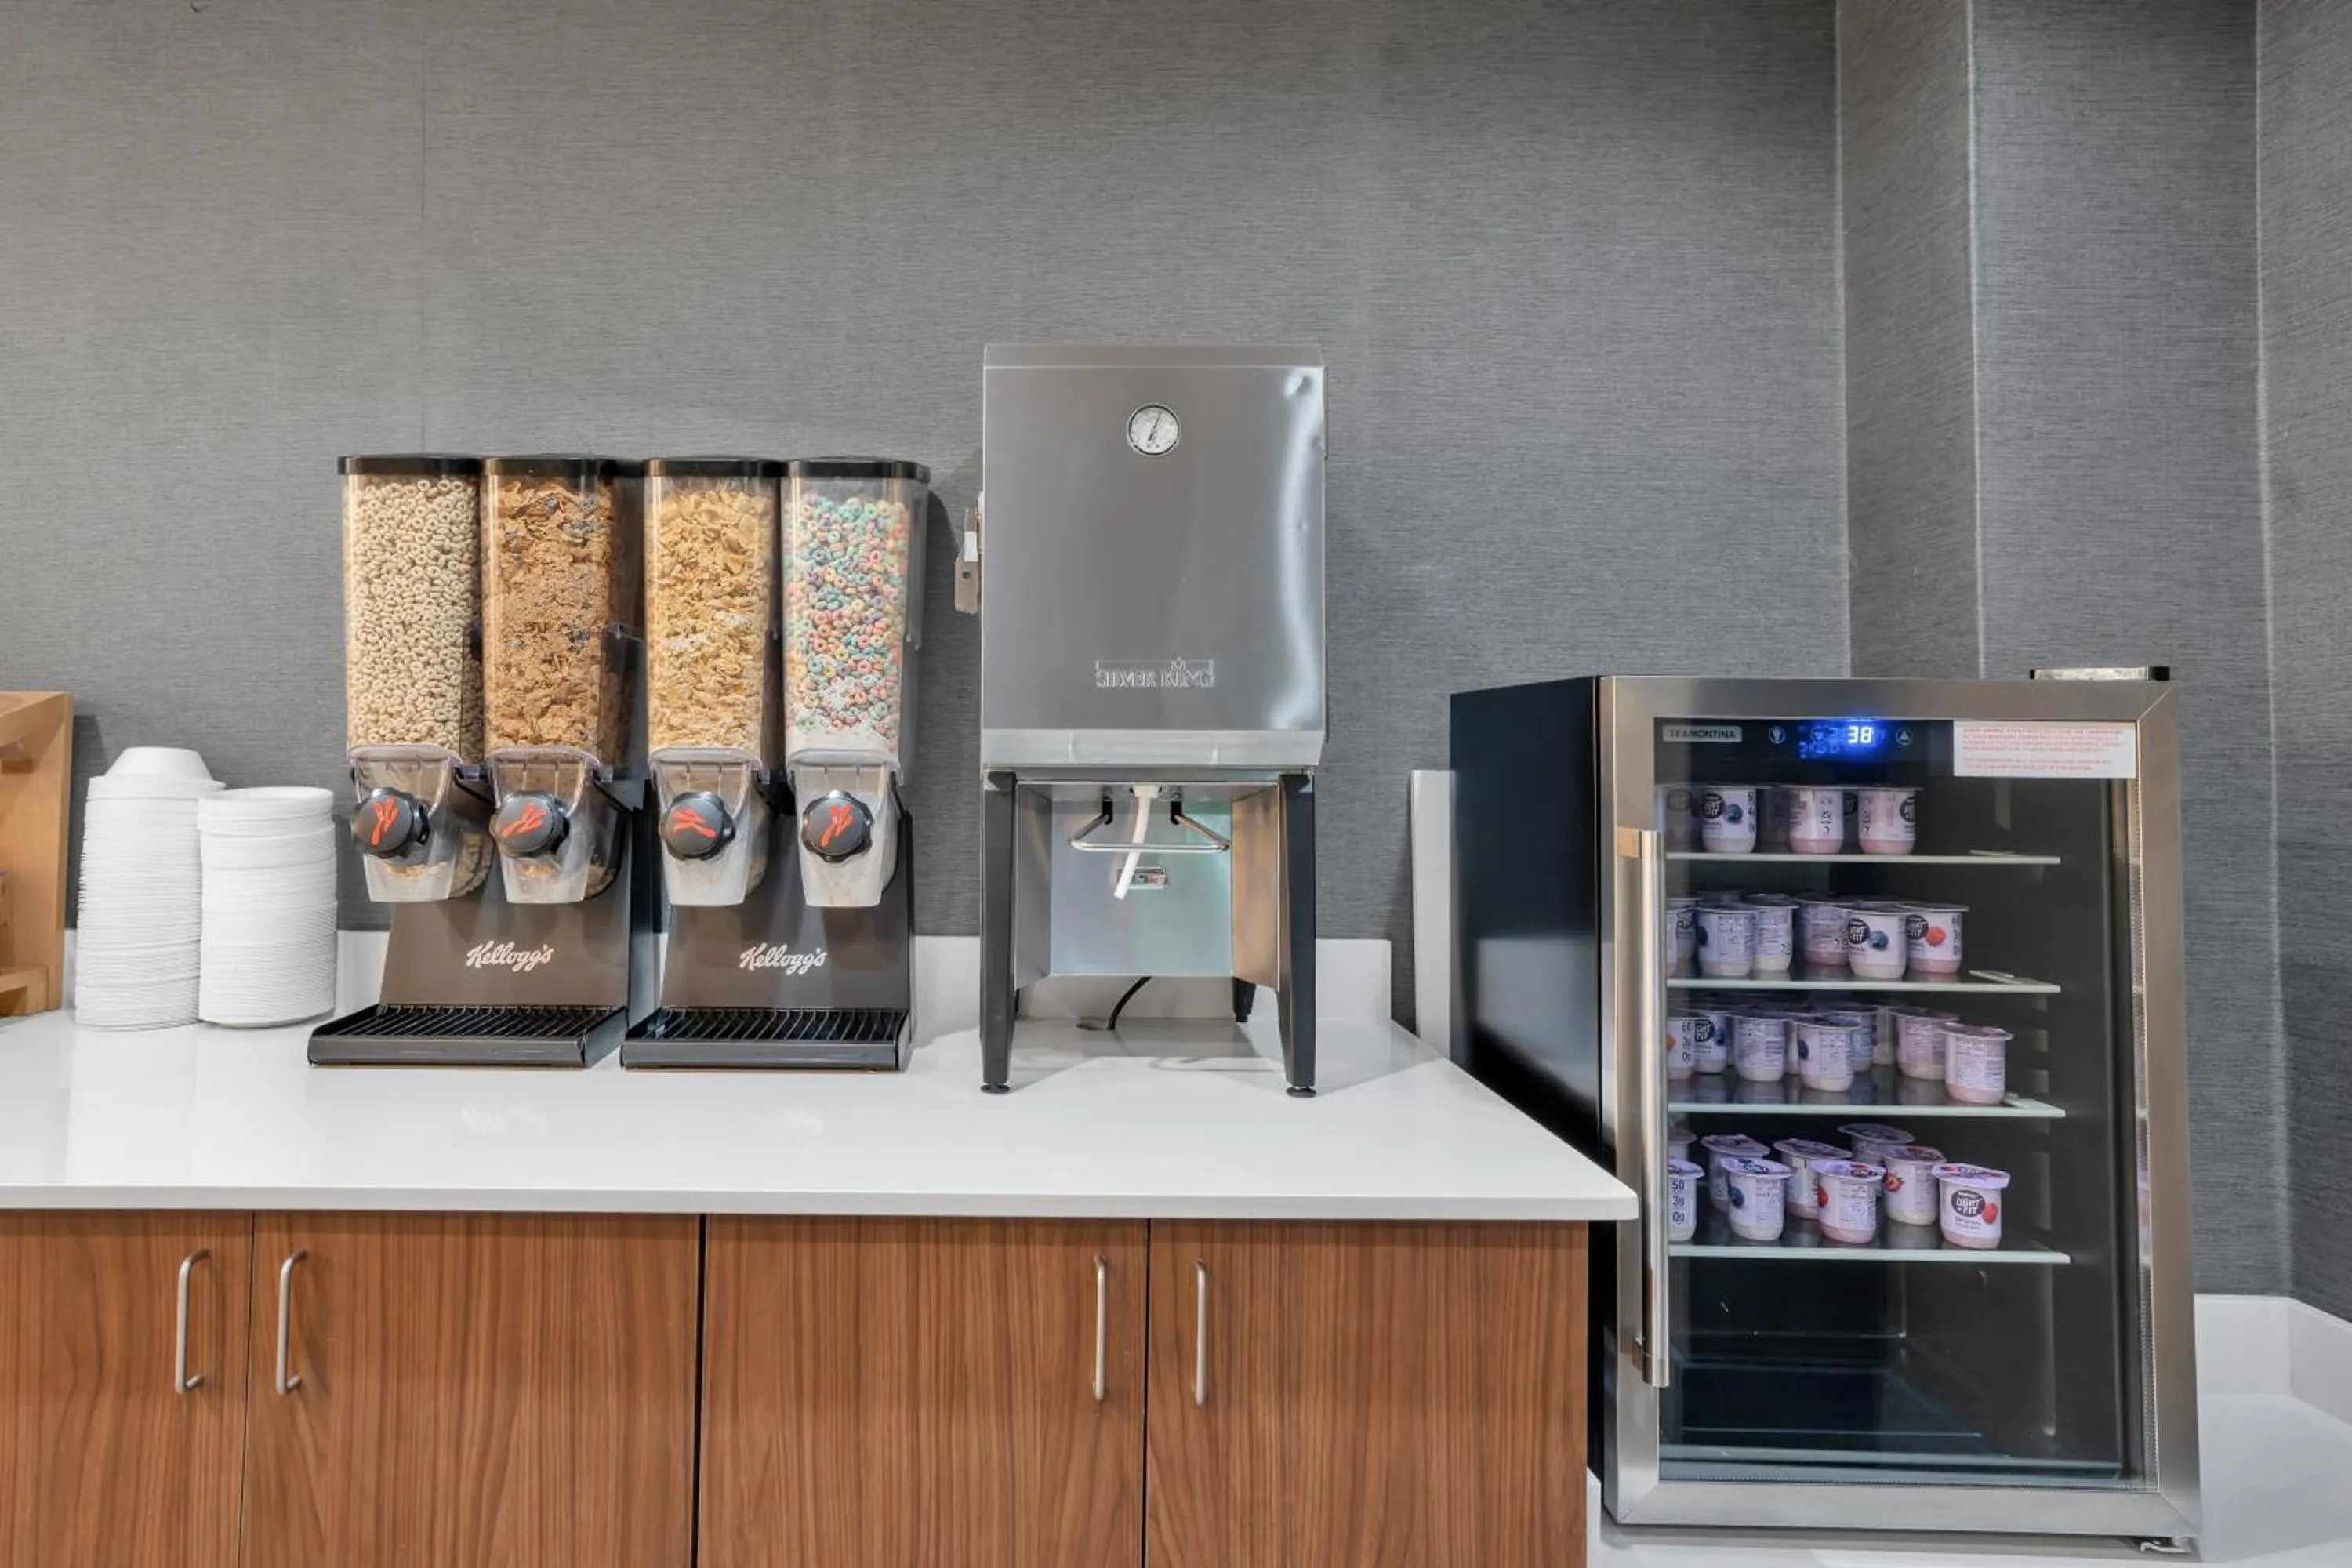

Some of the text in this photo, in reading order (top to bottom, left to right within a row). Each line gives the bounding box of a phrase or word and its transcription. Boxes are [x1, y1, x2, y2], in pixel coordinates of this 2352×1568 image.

[1847, 725, 1874, 745] 38
[465, 940, 554, 973] Kellogg's
[739, 942, 827, 976] Kellogg's
[1671, 1178, 1685, 1190] 50
